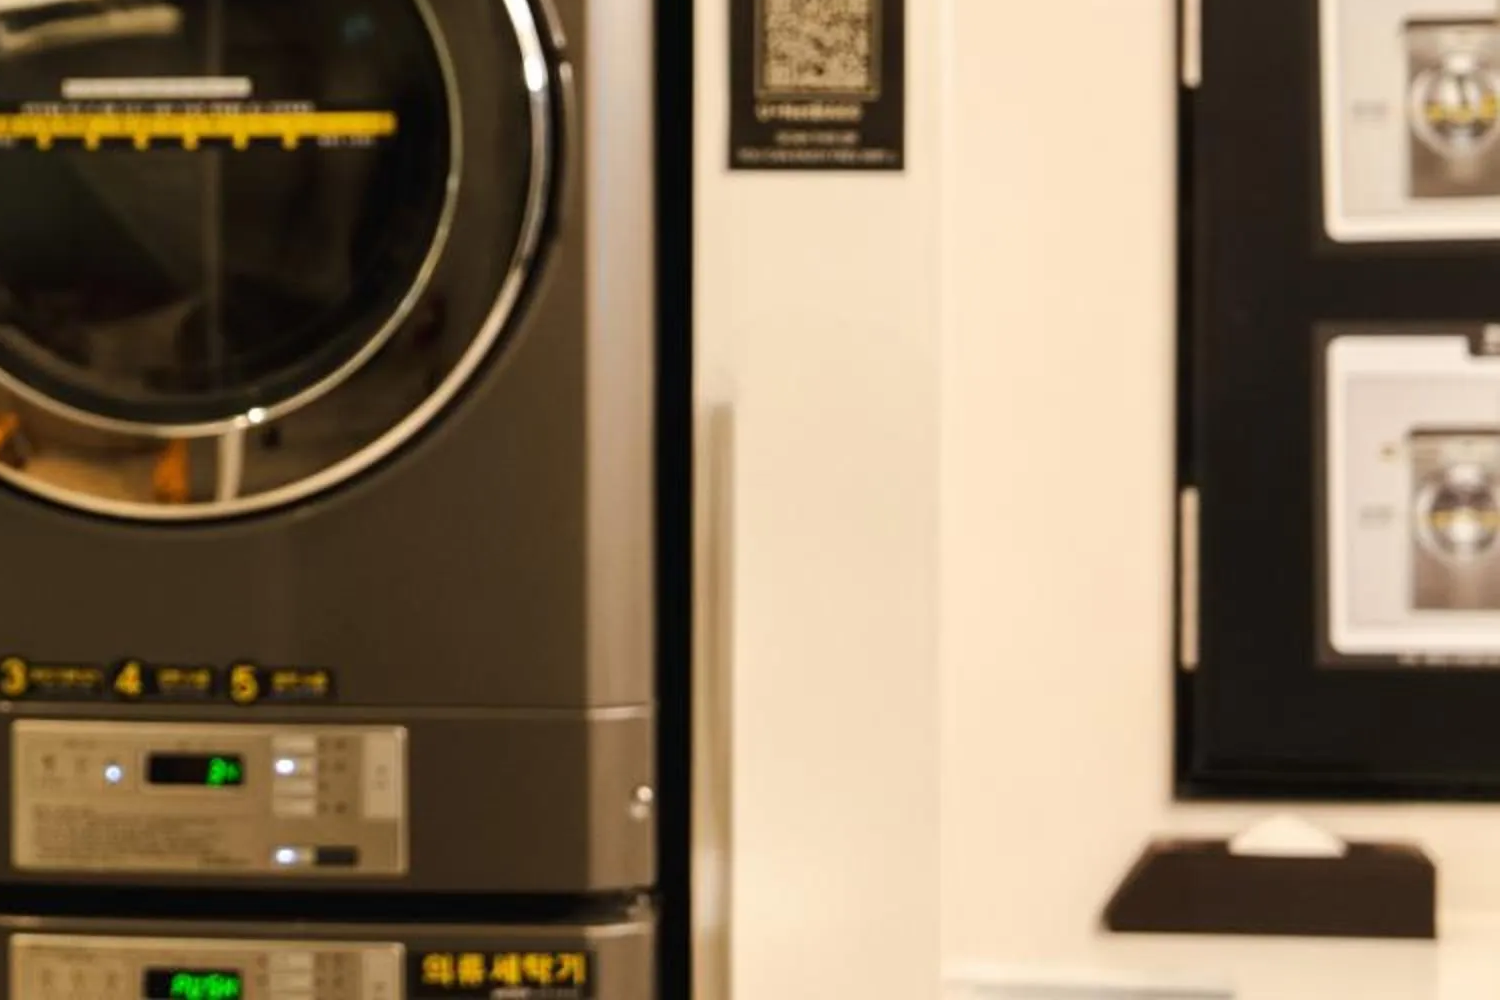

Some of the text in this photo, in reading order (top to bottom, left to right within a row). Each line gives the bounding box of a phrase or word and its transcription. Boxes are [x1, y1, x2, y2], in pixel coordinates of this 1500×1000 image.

[0, 656, 27, 696] 3
[114, 660, 142, 696] 4
[231, 663, 259, 702] 5
